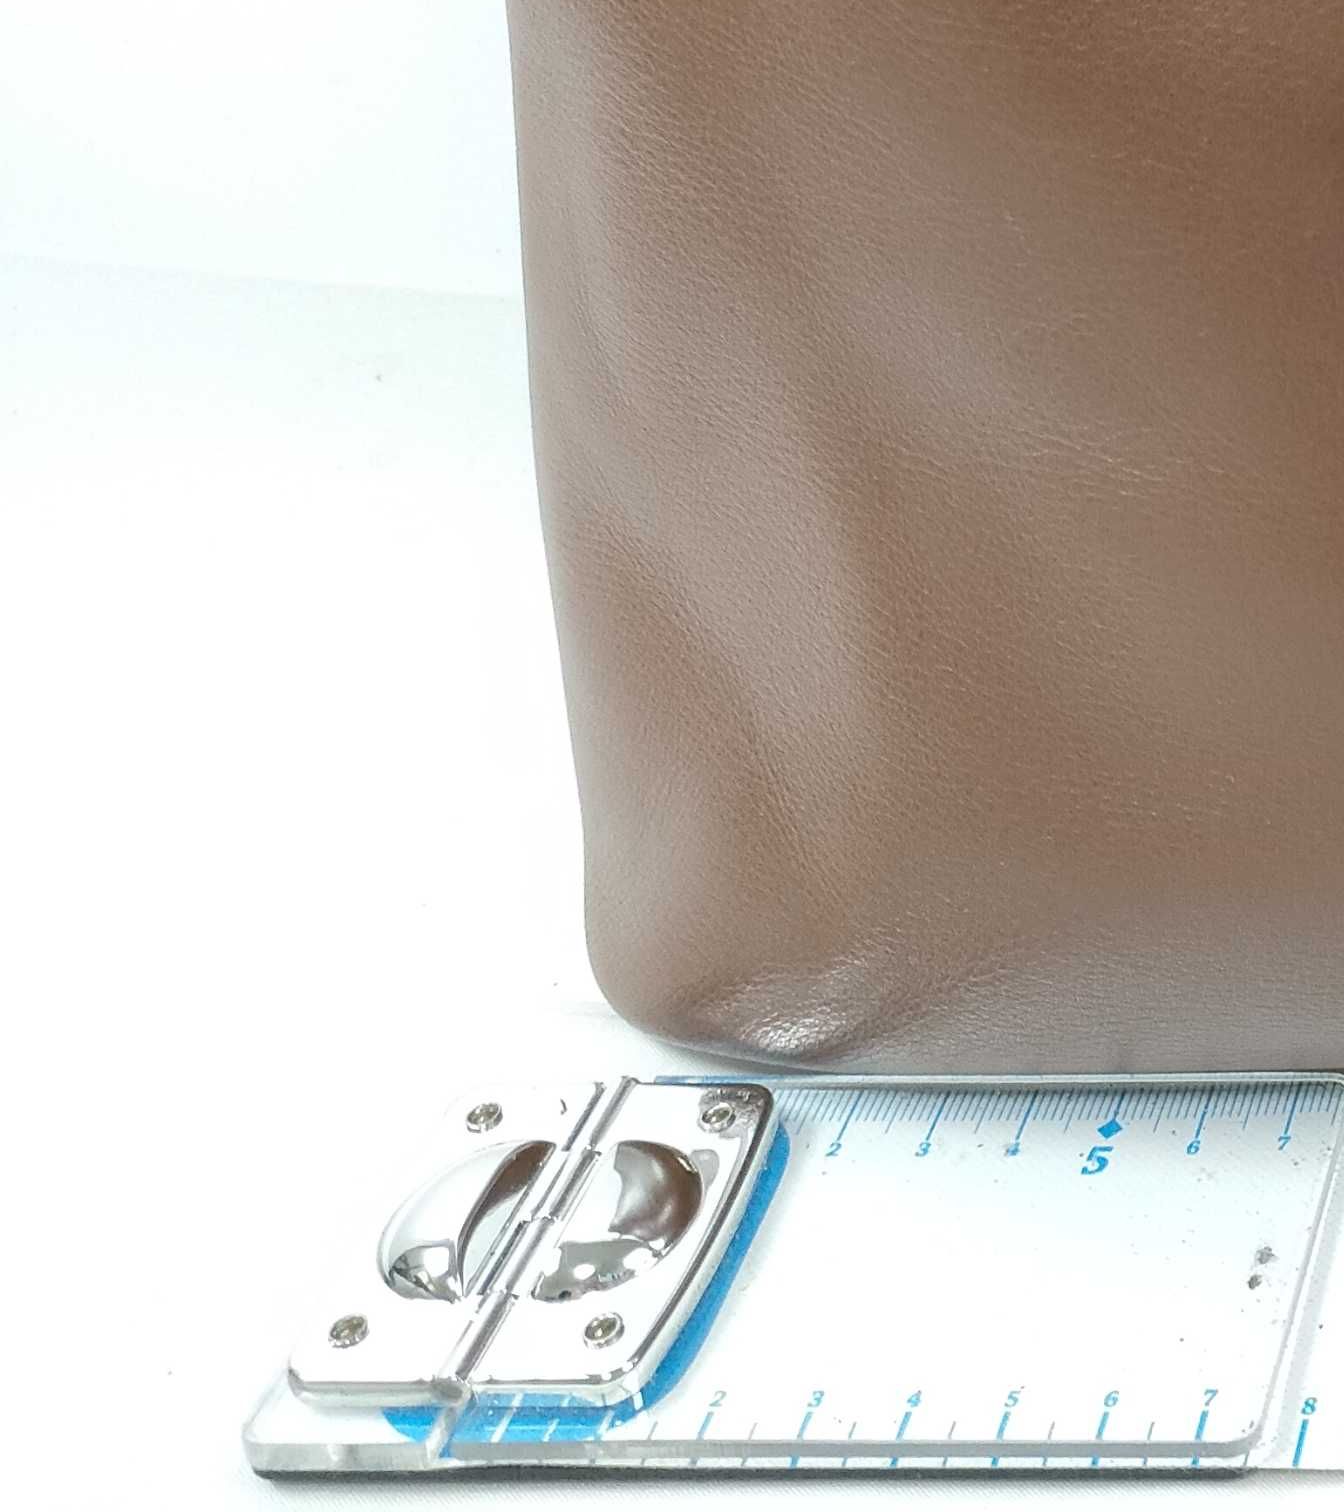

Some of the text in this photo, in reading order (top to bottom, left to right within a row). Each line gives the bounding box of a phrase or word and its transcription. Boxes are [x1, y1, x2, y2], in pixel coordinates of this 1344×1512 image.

[825, 1143, 842, 1156] 2
[915, 1143, 930, 1157] 3
[1004, 1144, 1020, 1156] 4
[1081, 1147, 1113, 1174] 5
[1186, 1141, 1200, 1155] 6
[1277, 1137, 1292, 1151] 7
[709, 1390, 727, 1407] 2
[808, 1391, 825, 1407] 3
[907, 1391, 922, 1407] 4
[1004, 1391, 1021, 1407] 5
[1103, 1391, 1120, 1407] 6
[1203, 1390, 1218, 1406] 7
[1301, 1398, 1317, 1415] 8
